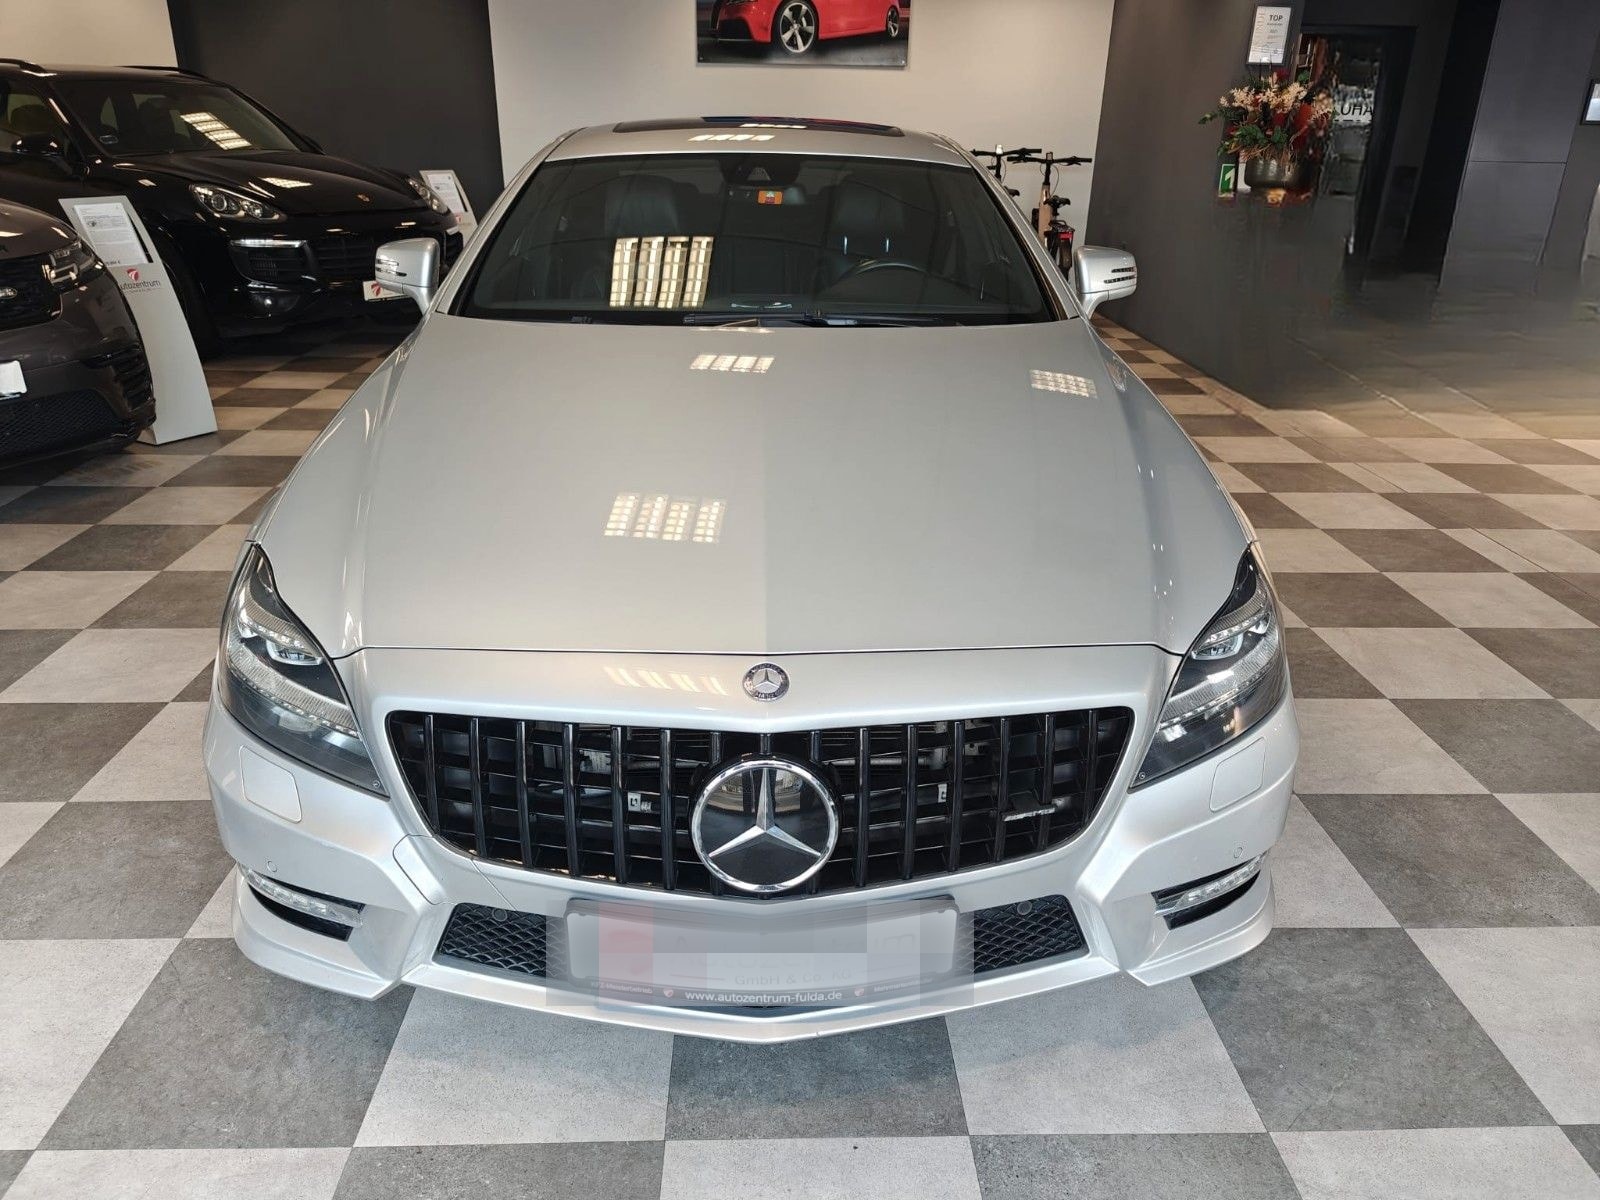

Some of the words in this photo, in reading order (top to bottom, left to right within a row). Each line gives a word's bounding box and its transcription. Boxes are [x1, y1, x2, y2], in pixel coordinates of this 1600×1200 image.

[1269, 14, 1284, 22] TOP
[119, 280, 161, 291] utozentrum
[684, 990, 843, 1004] www.autozentrum-fulda.de
